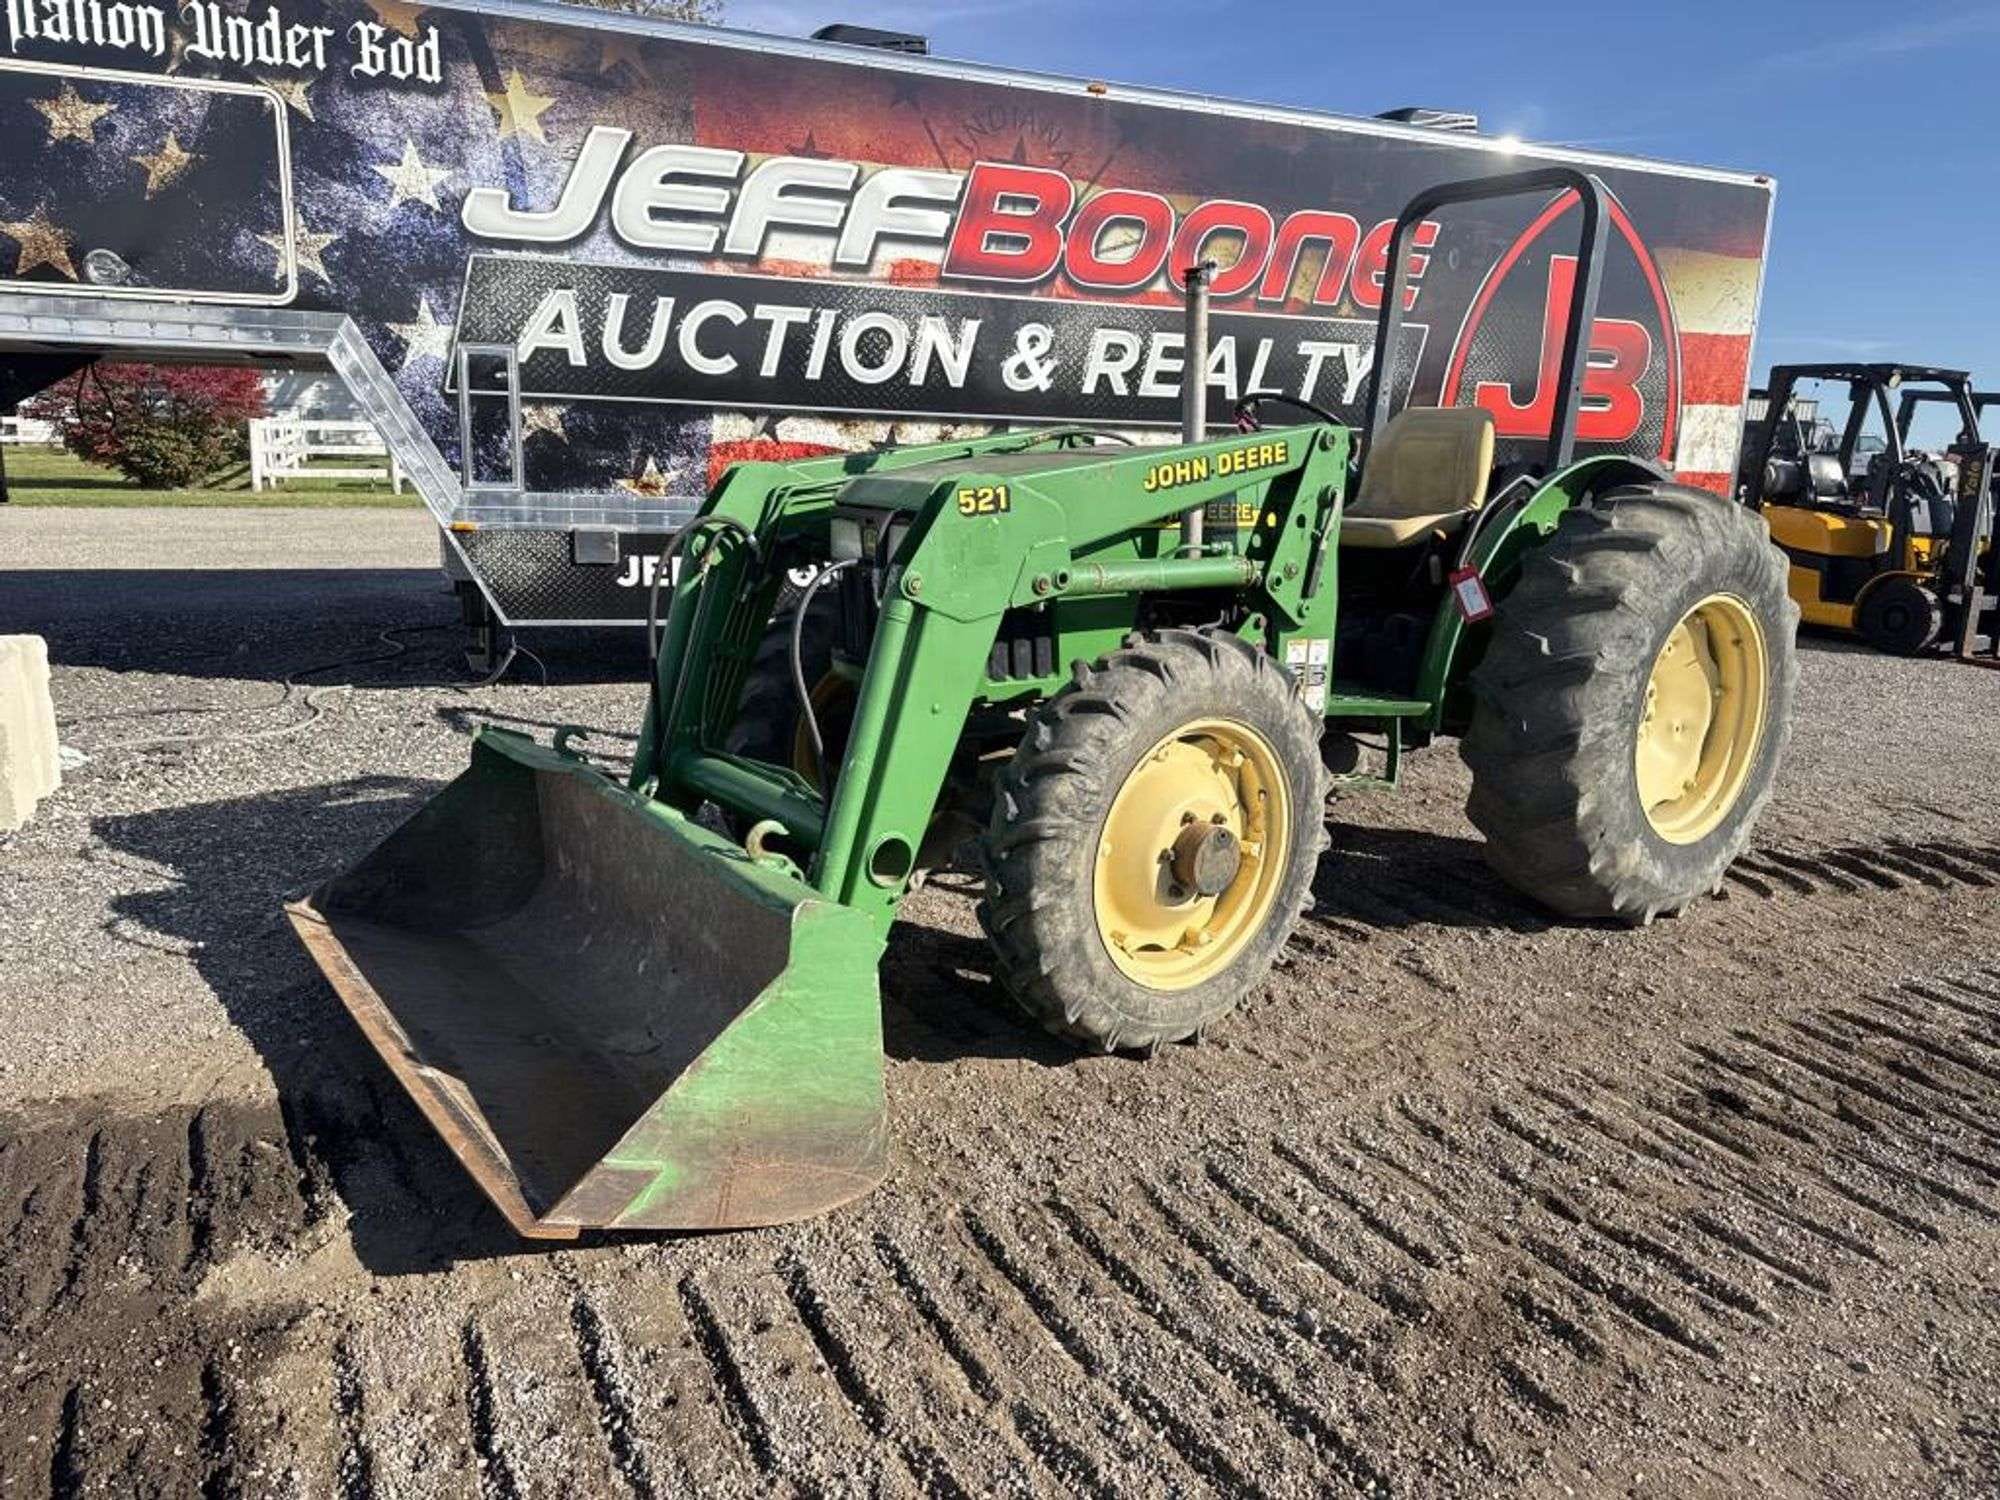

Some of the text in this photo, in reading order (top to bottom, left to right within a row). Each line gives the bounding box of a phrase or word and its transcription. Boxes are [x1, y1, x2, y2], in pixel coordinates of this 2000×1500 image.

[181, 0, 335, 71] Under
[347, 19, 443, 84] God
[518, 288, 1376, 405] AUCTION & REALTY
[1143, 441, 1288, 491] JOHN DEERE
[957, 485, 1010, 516] 521
[1207, 503, 1252, 520] EERE
